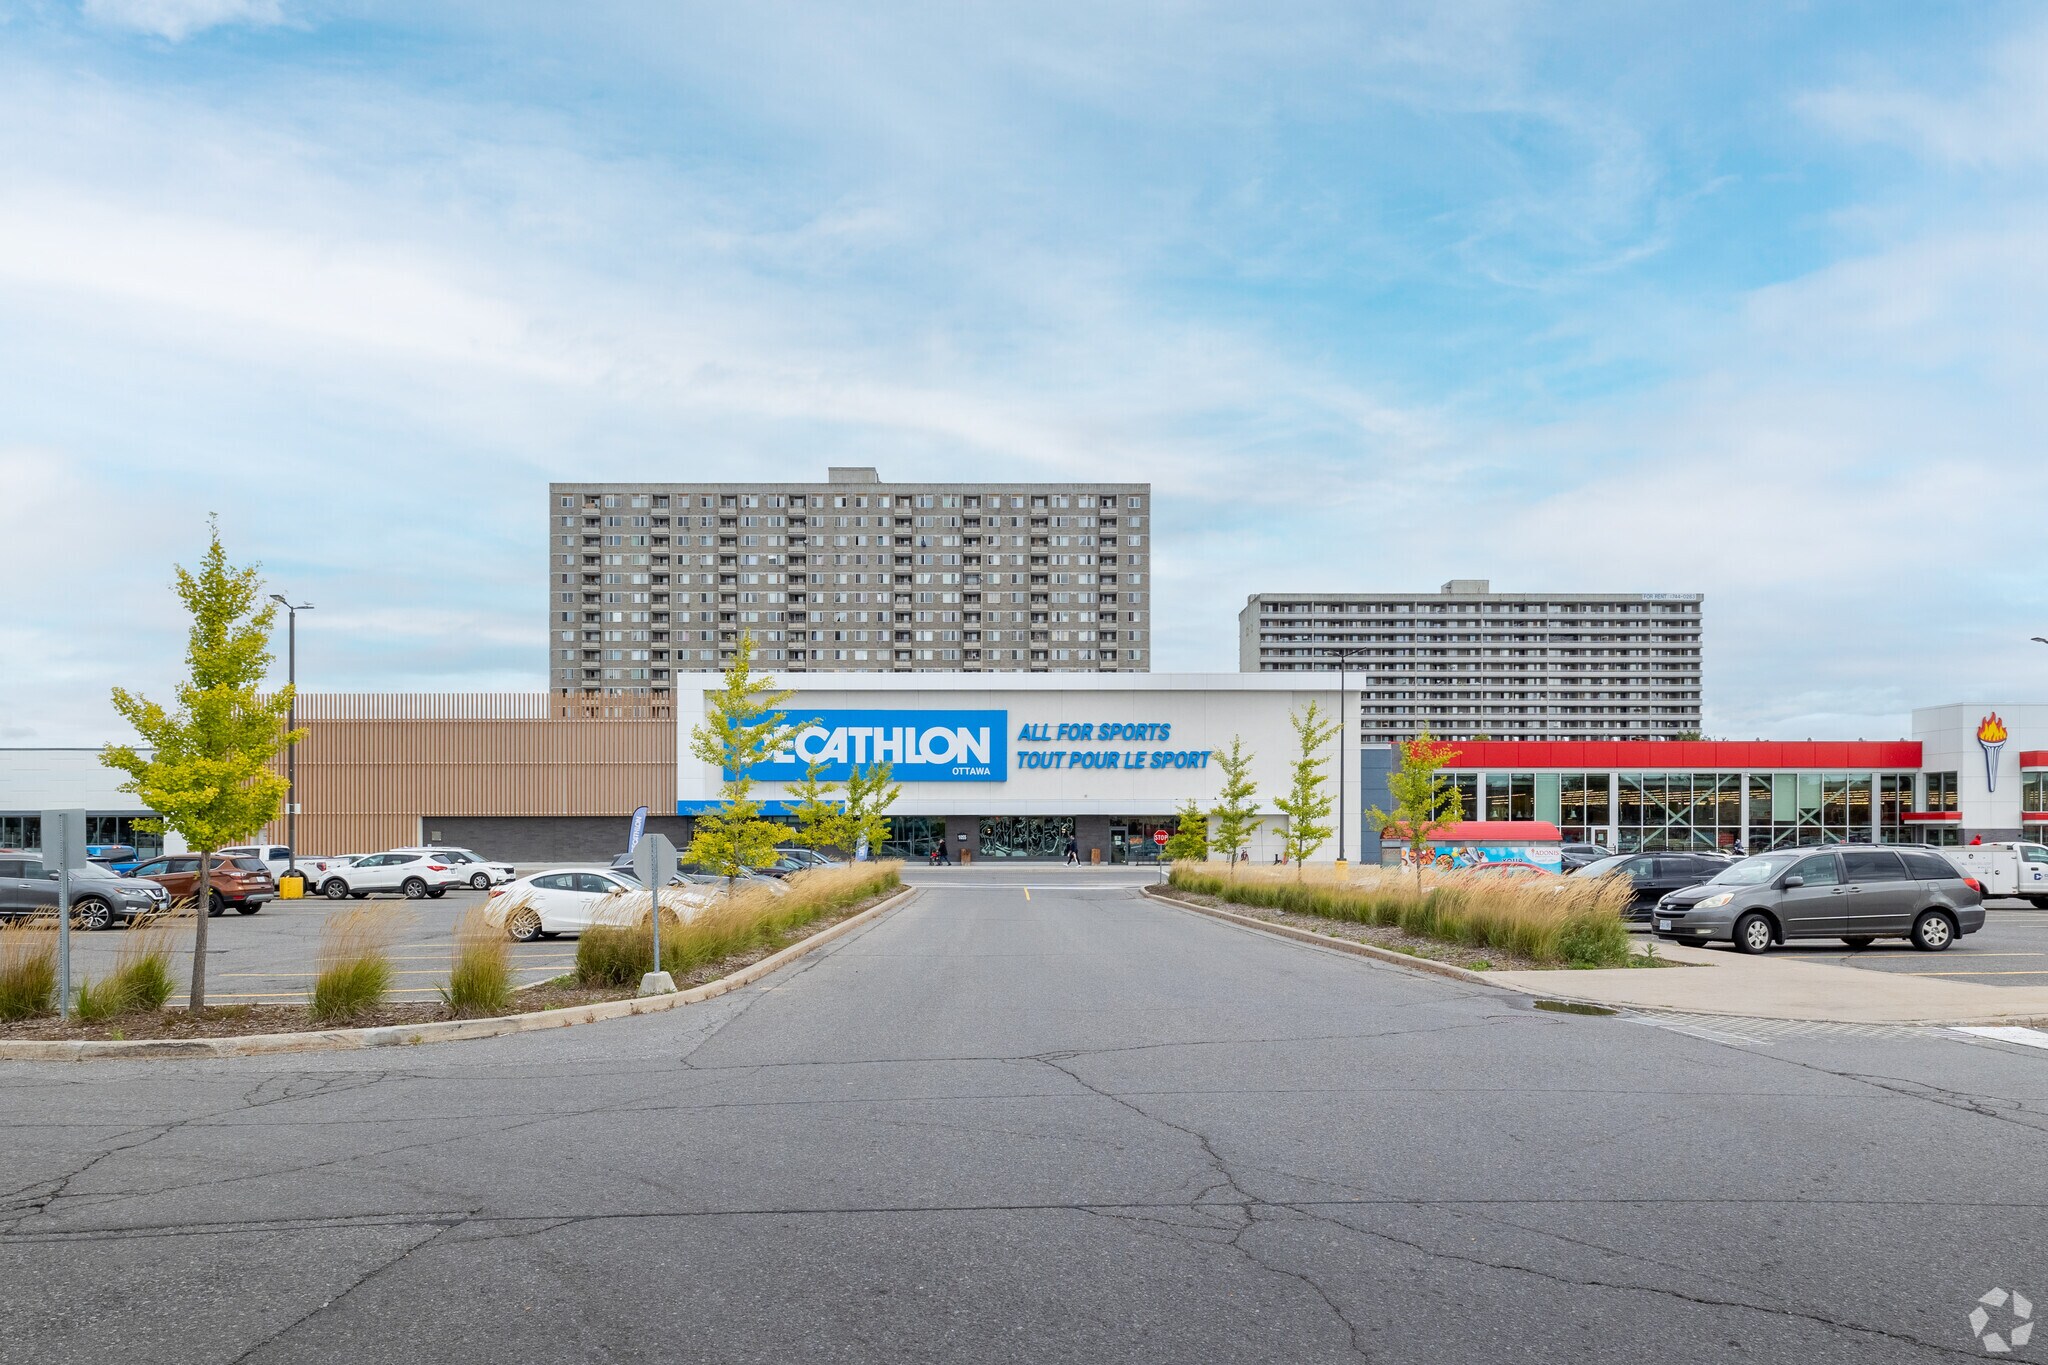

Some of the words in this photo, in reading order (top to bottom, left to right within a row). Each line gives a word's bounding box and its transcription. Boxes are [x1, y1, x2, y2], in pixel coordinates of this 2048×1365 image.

[1018, 723, 1053, 741] ALL
[1057, 723, 1094, 741] FOR
[1098, 723, 1172, 741] SPORTS
[1017, 751, 1067, 769] TOUT
[1068, 751, 1121, 769] POUR
[1124, 751, 1148, 769] LE
[1150, 751, 1212, 769] SPORT
[952, 767, 990, 775] OTTAWA
